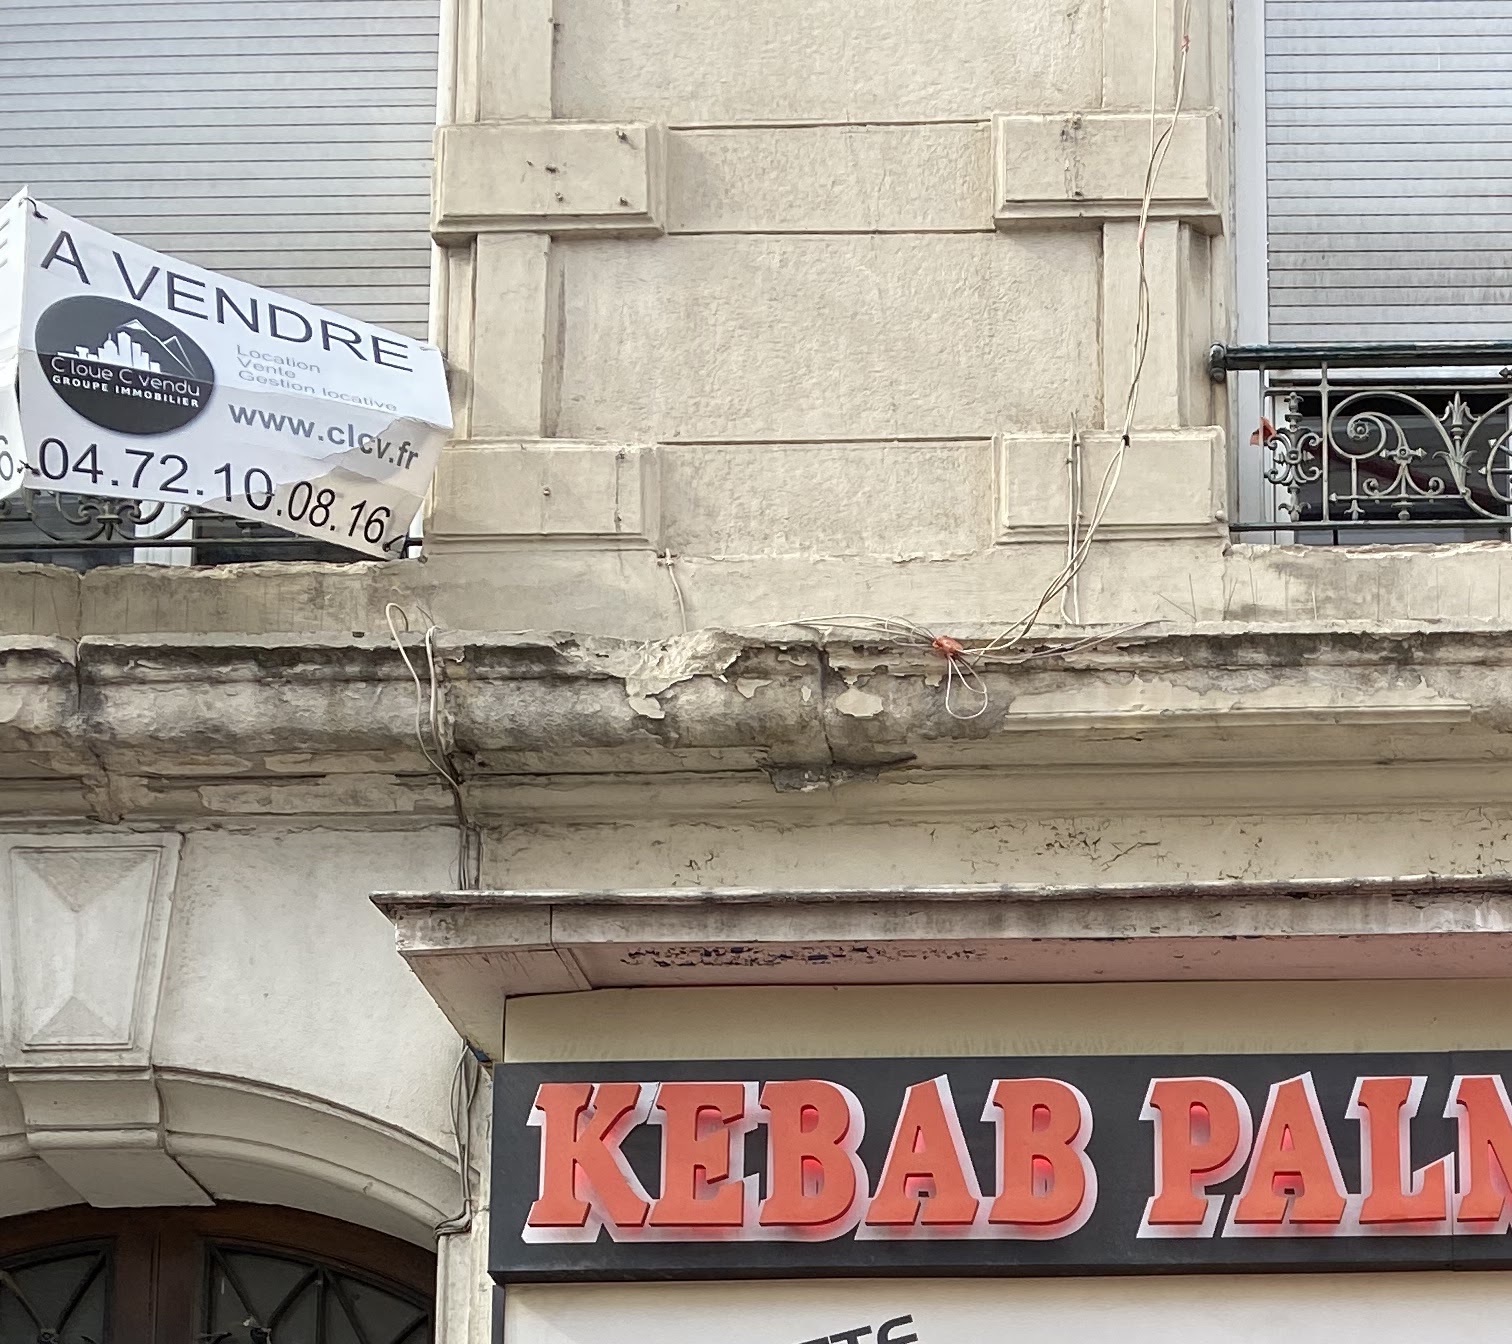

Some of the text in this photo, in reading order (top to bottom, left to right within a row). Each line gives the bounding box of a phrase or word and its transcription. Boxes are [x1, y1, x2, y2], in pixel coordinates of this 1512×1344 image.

[40, 230, 91, 286] A
[112, 251, 414, 373] VENDRE
[69, 360, 114, 382] loue
[138, 373, 201, 396] vendu
[236, 344, 321, 374] Location
[237, 356, 297, 379] Vente
[52, 374, 200, 408] GROUPE IMMOBILIER
[238, 370, 398, 412] Gestion locative
[228, 403, 419, 470] www.clcv.fr
[38, 437, 392, 544] 04.72.10.08.16
[521, 1073, 1098, 1243] KEBAB
